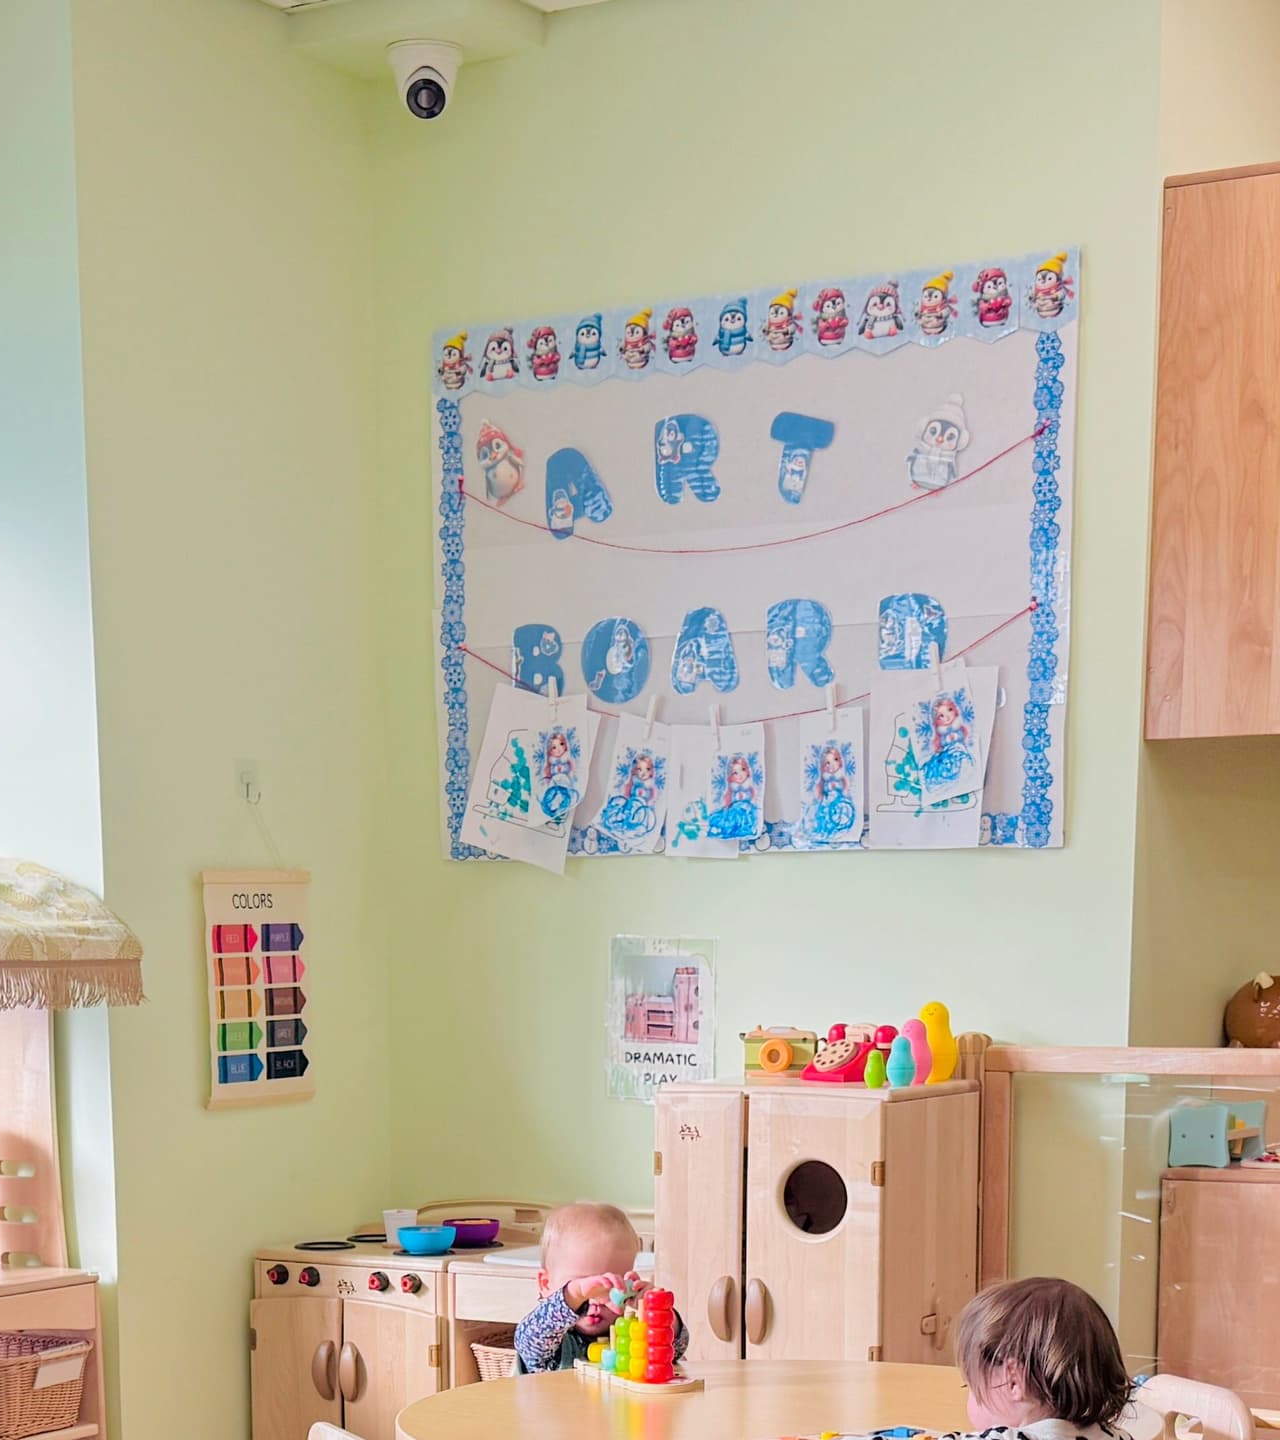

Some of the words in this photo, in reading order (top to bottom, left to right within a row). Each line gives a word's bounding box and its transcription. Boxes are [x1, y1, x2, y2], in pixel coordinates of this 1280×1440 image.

[545, 411, 835, 540] ART
[511, 592, 949, 704] BOARD
[232, 893, 273, 910] COLORS
[624, 1051, 698, 1067] DRAMATIC
[643, 1073, 678, 1086] PLAY
